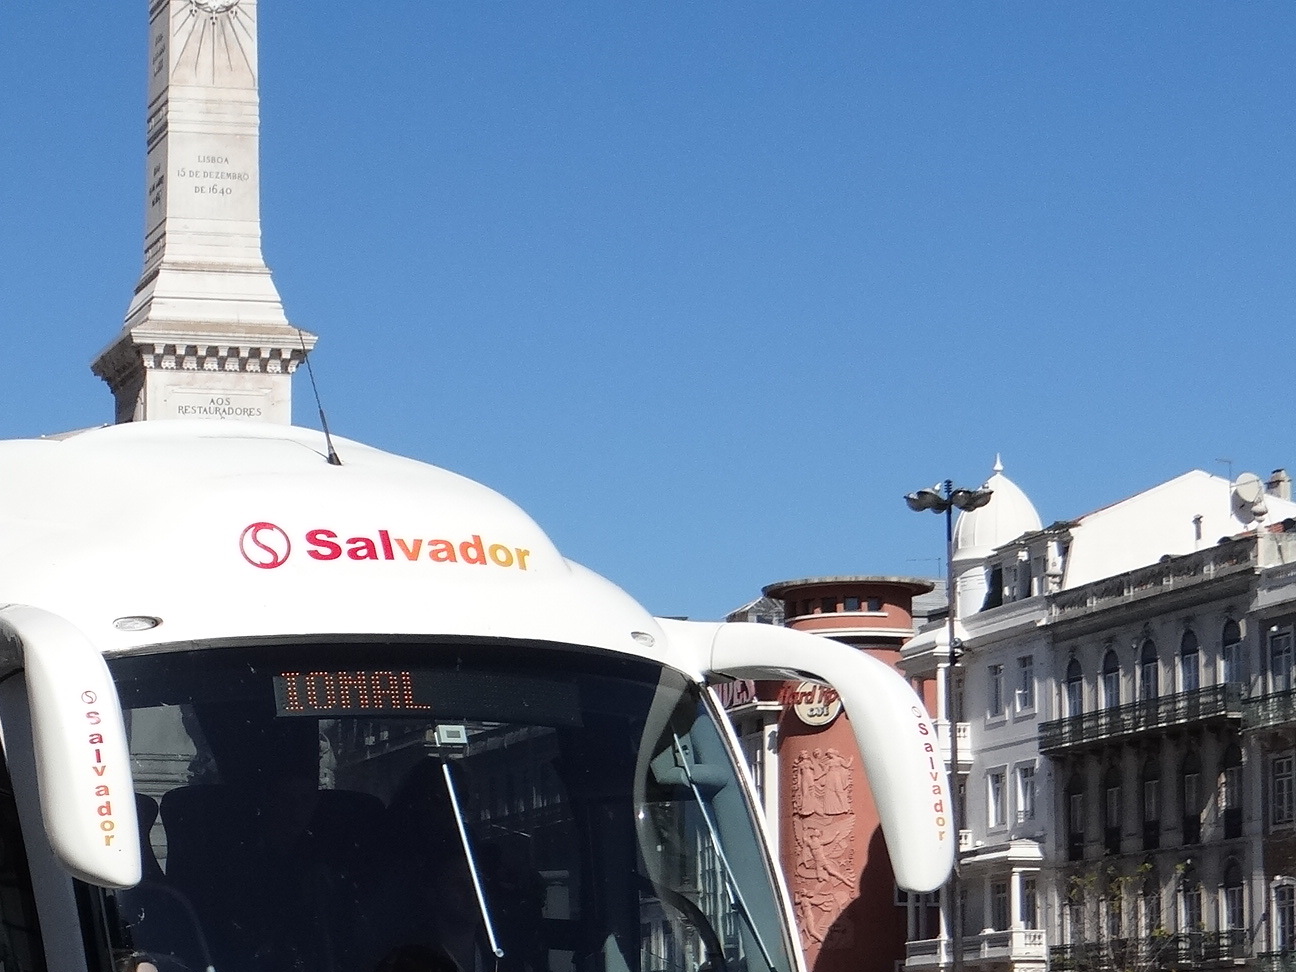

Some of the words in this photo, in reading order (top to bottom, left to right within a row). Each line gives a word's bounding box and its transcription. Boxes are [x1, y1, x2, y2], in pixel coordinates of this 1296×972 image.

[197, 155, 229, 164] LISBOA
[189, 170, 200, 178] DE
[204, 171, 250, 181] DEZEMBRO
[194, 186, 205, 194] DE
[209, 184, 232, 196] 1640
[209, 397, 231, 406] AOS
[178, 405, 262, 418] RESTAURADORES
[305, 529, 530, 571] Salvador
[85, 711, 115, 846] Salvador
[918, 722, 947, 842] Salvador
